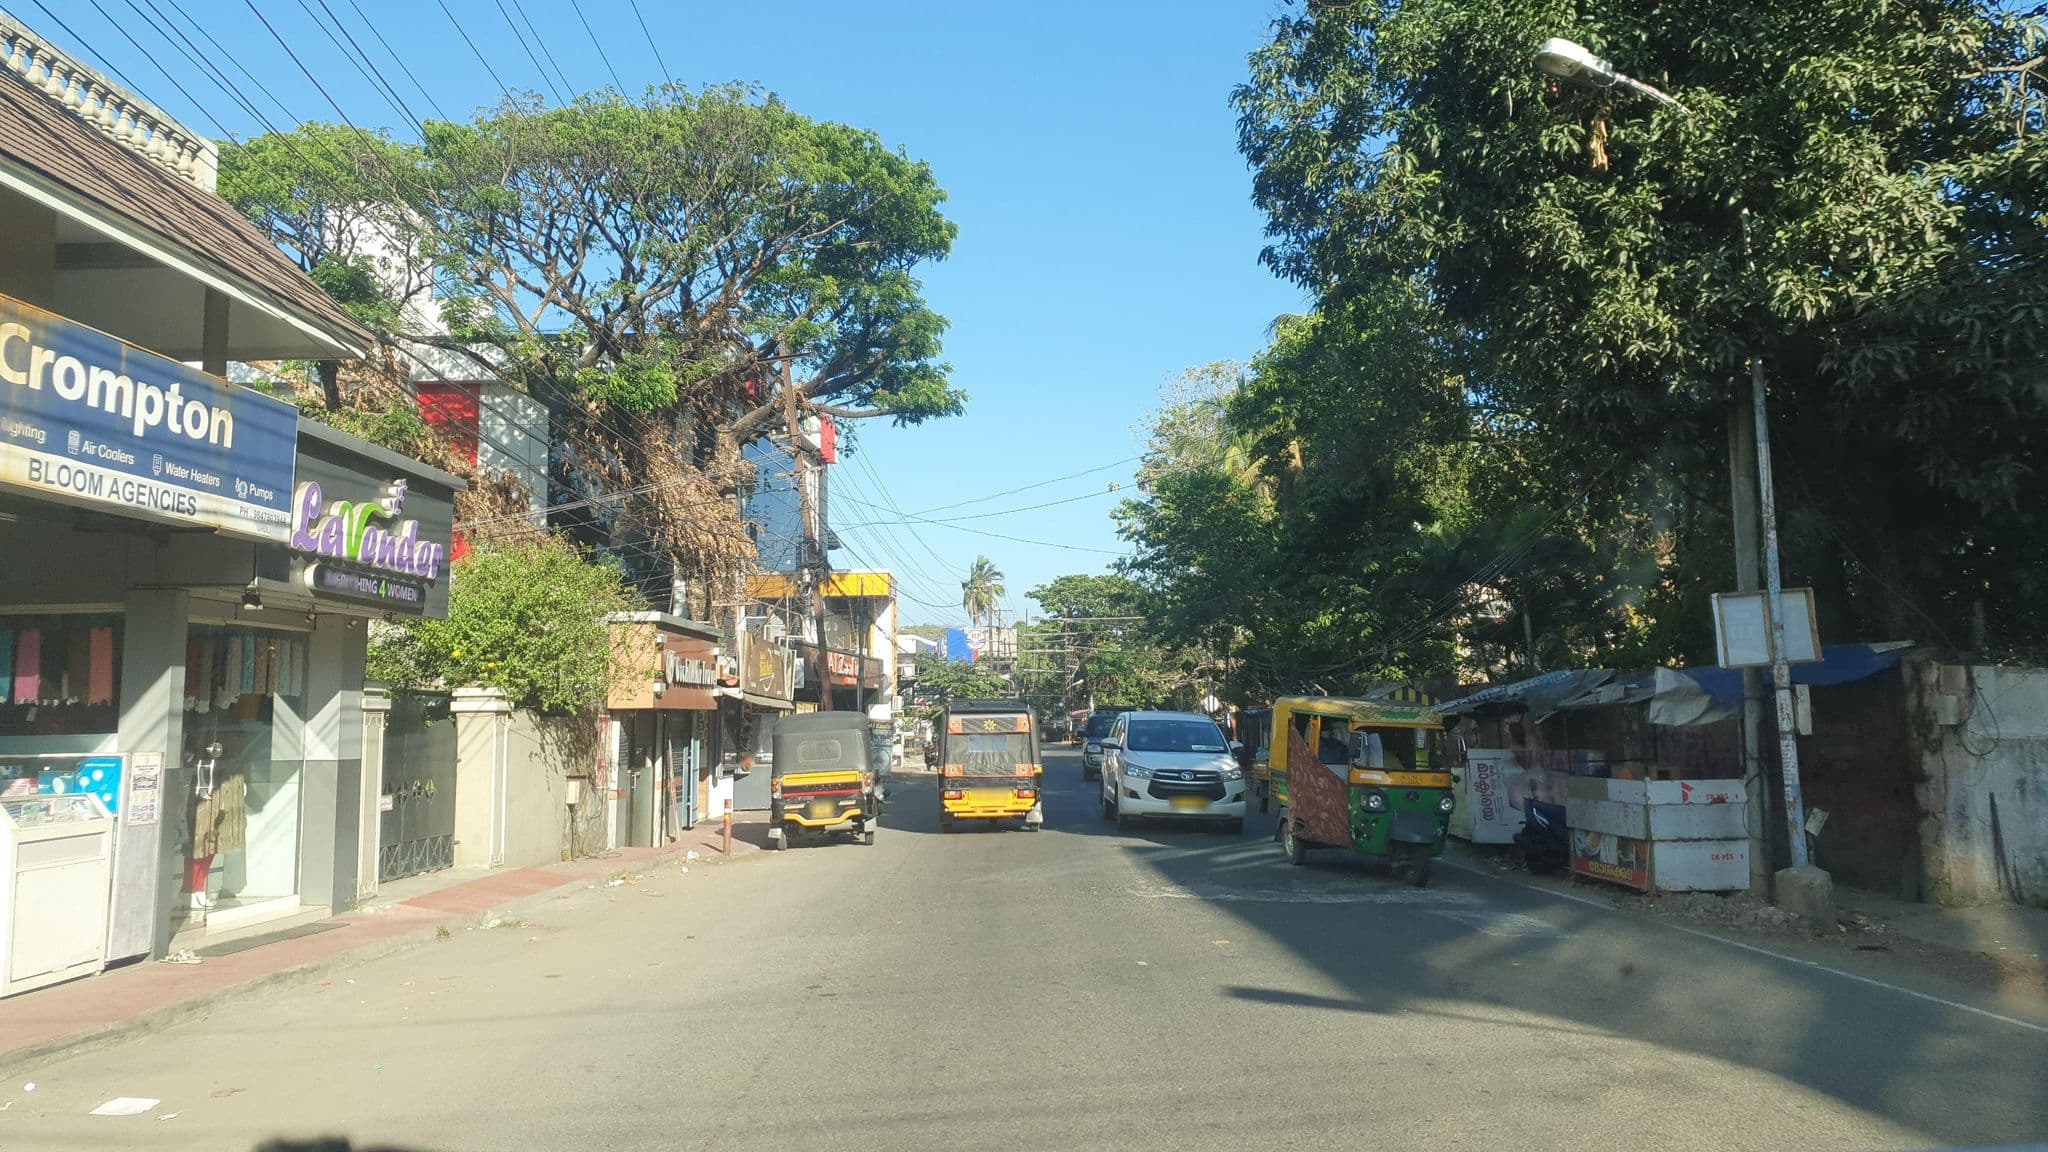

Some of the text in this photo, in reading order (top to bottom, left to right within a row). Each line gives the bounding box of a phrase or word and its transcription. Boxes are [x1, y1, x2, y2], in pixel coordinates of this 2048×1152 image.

[0, 321, 235, 449] Crompton
[81, 439, 136, 466] Air Coolers
[28, 457, 198, 517] BLOOM AGENCIES
[165, 461, 221, 488] Water Heaters
[249, 483, 274, 502] Pumps
[239, 505, 249, 518] PH
[322, 569, 418, 602] ERHING 4 WOMEN
